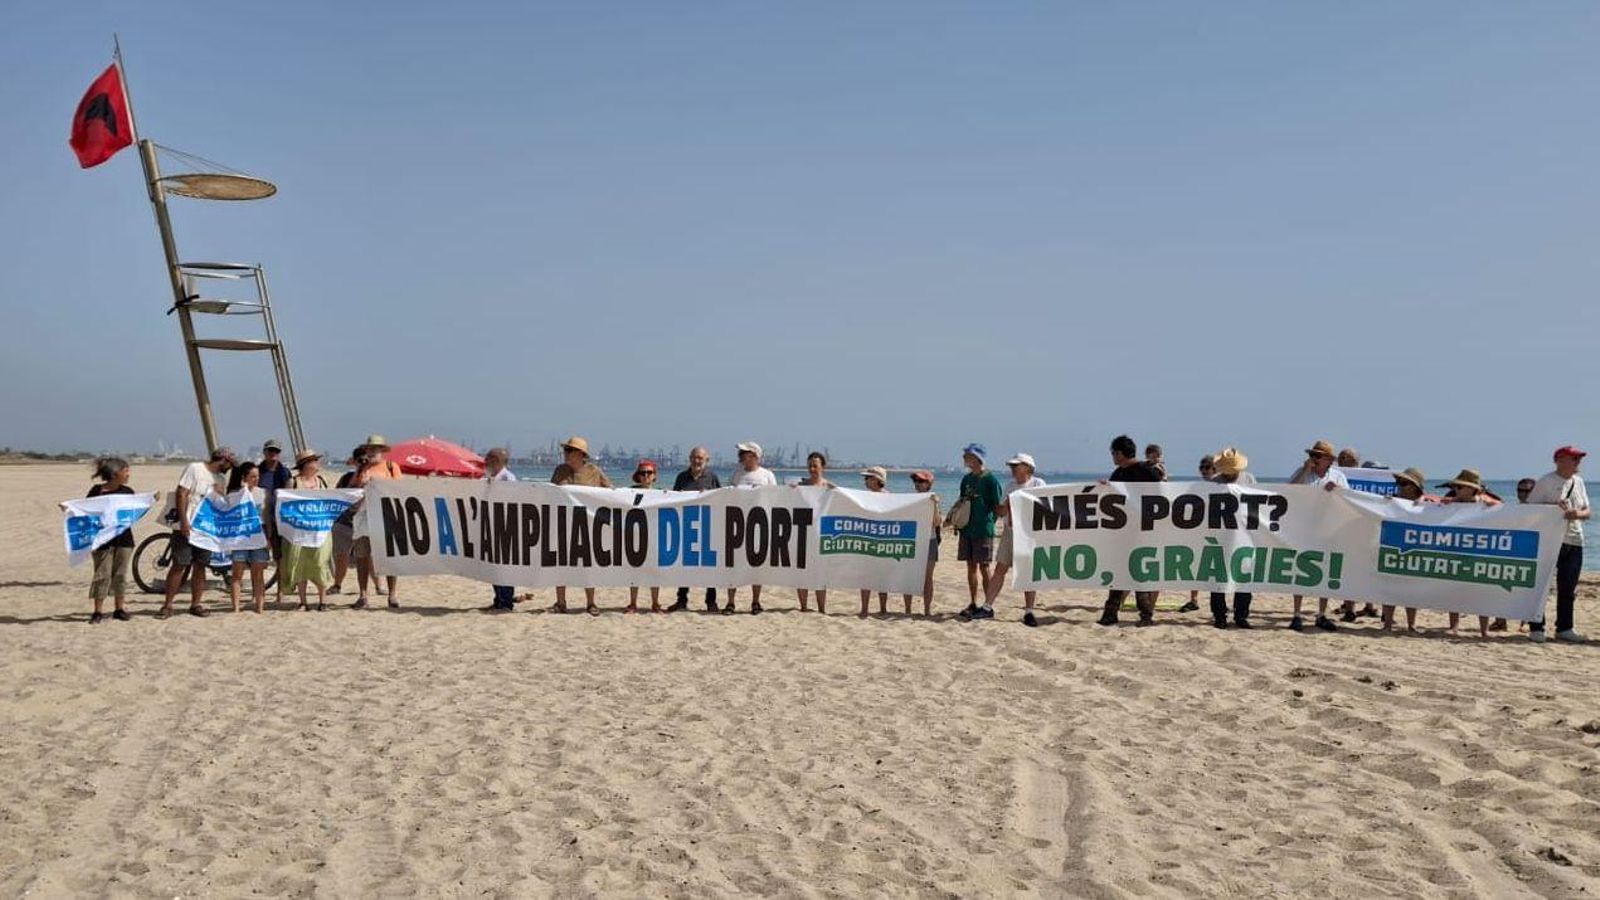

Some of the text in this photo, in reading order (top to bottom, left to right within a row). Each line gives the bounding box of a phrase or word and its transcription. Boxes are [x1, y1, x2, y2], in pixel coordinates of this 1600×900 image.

[381, 494, 813, 569] NO A L'AMPLIACIÓ DEL PORT
[834, 520, 901, 535] COMISSIÓ
[1032, 485, 1288, 532] MÉS PORT?
[1032, 537, 1343, 590] NO, GRÀCIES!
[1404, 529, 1513, 551] COMISSIÓ
